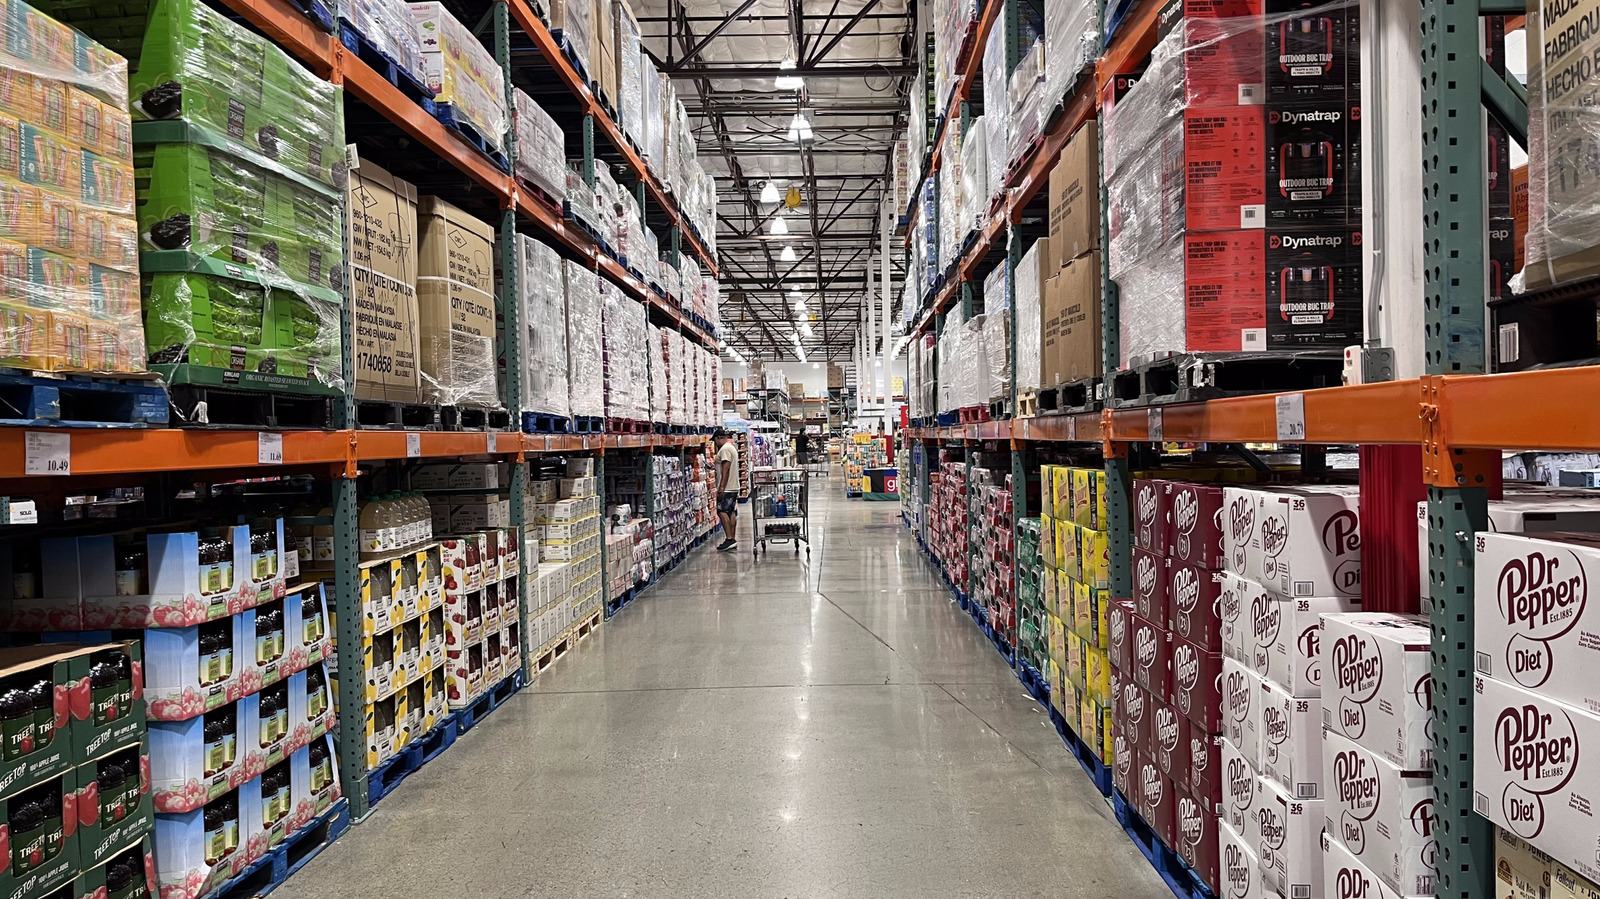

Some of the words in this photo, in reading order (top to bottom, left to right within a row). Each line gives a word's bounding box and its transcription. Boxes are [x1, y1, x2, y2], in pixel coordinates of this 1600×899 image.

[1280, 55, 1306, 63] OUTDOOR
[1319, 53, 1333, 61] TRAP
[1546, 56, 1591, 103] HECHO
[1282, 110, 1341, 124] Dynatrap
[1279, 179, 1306, 187] OUTDOOR
[1319, 177, 1333, 185] TRAP
[1283, 235, 1341, 249] Dynatrap
[354, 268, 369, 284] QTY
[367, 287, 374, 298] 52
[356, 297, 369, 310] MADE
[369, 301, 374, 311] IN
[375, 302, 395, 316] MALAYSIA
[451, 297, 462, 310] QTY
[1280, 303, 1307, 312] OUTDOOR
[1320, 302, 1335, 310] TRAP
[356, 325, 372, 337] HECHO
[378, 316, 384, 326] EN
[358, 352, 392, 373] 1740658
[47, 460, 69, 471] 10.49
[1183, 489, 1191, 507] Dr
[1238, 495, 1248, 518] Dr
[1293, 500, 1305, 508] 36
[1174, 491, 1197, 530] Pepper
[1230, 501, 1253, 541] Pepper
[1476, 537, 1485, 548] 36
[1183, 568, 1192, 586] Dr
[1527, 551, 1559, 592] Dr
[1174, 570, 1197, 608] Pepper
[1498, 559, 1580, 630] Pepper
[1262, 593, 1272, 614] Dr
[1251, 597, 1279, 641] Pepper
[1183, 645, 1191, 662] Dr
[1348, 634, 1366, 664] Dr
[1175, 647, 1197, 684] Pepper
[1333, 638, 1379, 694] Pepper
[1515, 649, 1542, 673] Diet
[1475, 677, 1484, 690] 36
[1297, 701, 1309, 709] 36
[1156, 708, 1177, 745] Pepper
[1164, 707, 1172, 726] Dr
[1344, 709, 1360, 727] Diet
[1523, 704, 1552, 743] Dr
[1495, 707, 1572, 780] Pepper
[1237, 758, 1246, 779] Dr
[1349, 751, 1366, 779] Dr
[1228, 759, 1252, 802] Pepper
[1334, 751, 1377, 809] Pepper
[1179, 799, 1202, 837] Pepper
[1187, 798, 1196, 817] Dr
[1266, 809, 1276, 826] Dr
[1290, 804, 1303, 812] 36
[1510, 799, 1534, 821] Diet
[1258, 808, 1283, 843] Pepper
[1346, 823, 1360, 842] Diet
[1233, 845, 1242, 865] Dr
[1225, 844, 1248, 889] Pepper
[1353, 868, 1369, 898] Dr
[1556, 869, 1575, 892] Fallout
